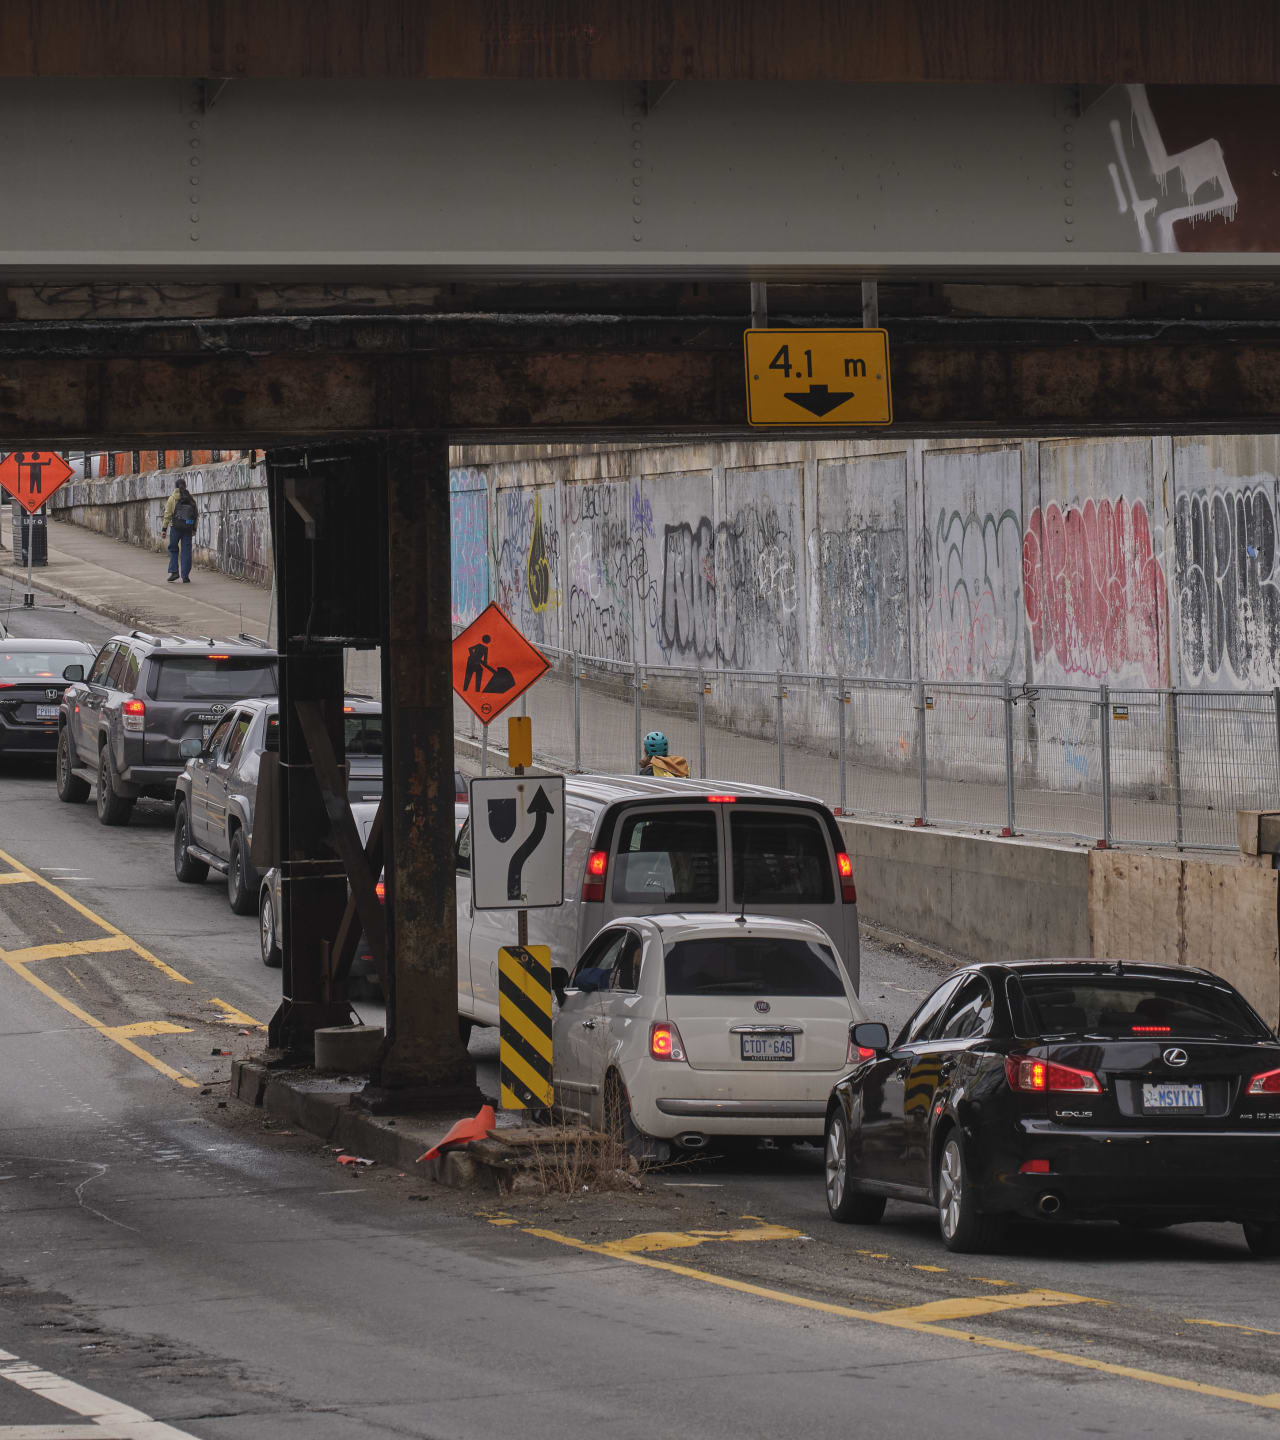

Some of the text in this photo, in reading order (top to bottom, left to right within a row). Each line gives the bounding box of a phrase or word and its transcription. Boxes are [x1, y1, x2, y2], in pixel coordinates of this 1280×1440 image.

[769, 345, 867, 378] 4.1 m
[1158, 1090, 1203, 1107] MSVIKI
[1055, 1110, 1093, 1118] LEXUS
